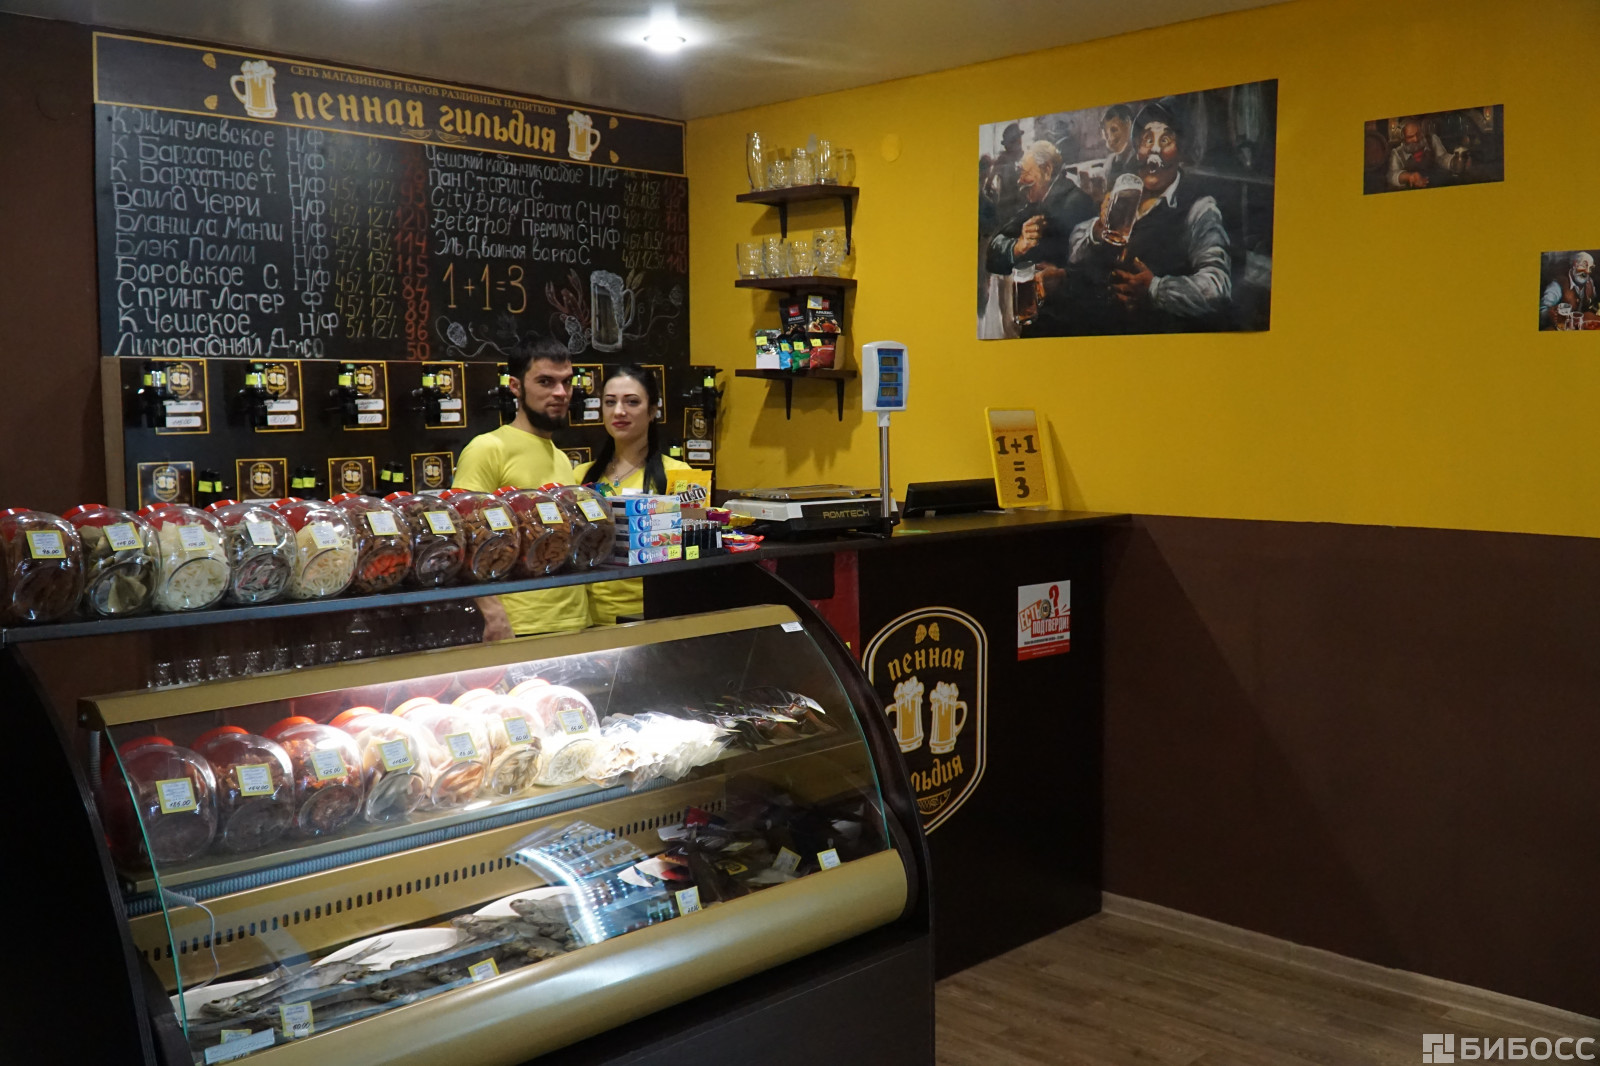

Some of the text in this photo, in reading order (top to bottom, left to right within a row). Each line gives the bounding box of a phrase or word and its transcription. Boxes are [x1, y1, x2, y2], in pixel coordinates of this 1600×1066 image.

[290, 65, 557, 116] СЕТЬ МАГАЗИНОВ И БАРОВ РАЗЛИВНЫХ НАПИТКОВ
[132, 108, 275, 148] Жигулевское
[291, 91, 556, 154] пенная гильдия
[138, 135, 255, 170] Бархатное
[139, 159, 259, 191] Бархатное
[428, 168, 461, 188] Пан
[192, 186, 261, 218] Черри
[430, 185, 472, 214] City
[474, 192, 522, 216] Brew
[523, 198, 572, 221] Прага
[430, 208, 516, 236] Peterhof
[521, 218, 575, 241] Премиум
[114, 232, 179, 260] Блэк
[188, 237, 256, 264] Полли
[434, 228, 464, 256] Эль
[115, 256, 244, 286] Боровское
[117, 281, 209, 310] Спринг
[210, 286, 285, 314] Лагер
[300, 291, 323, 313] Ф
[144, 307, 251, 336] Чешское
[114, 331, 262, 357] Лимонадный
[406, 342, 431, 361] 50
[996, 435, 1037, 455] 1+1
[1015, 477, 1030, 498] 3
[822, 509, 870, 519] ROMITECH
[887, 647, 965, 681] пенная
[910, 754, 965, 793] льдия
